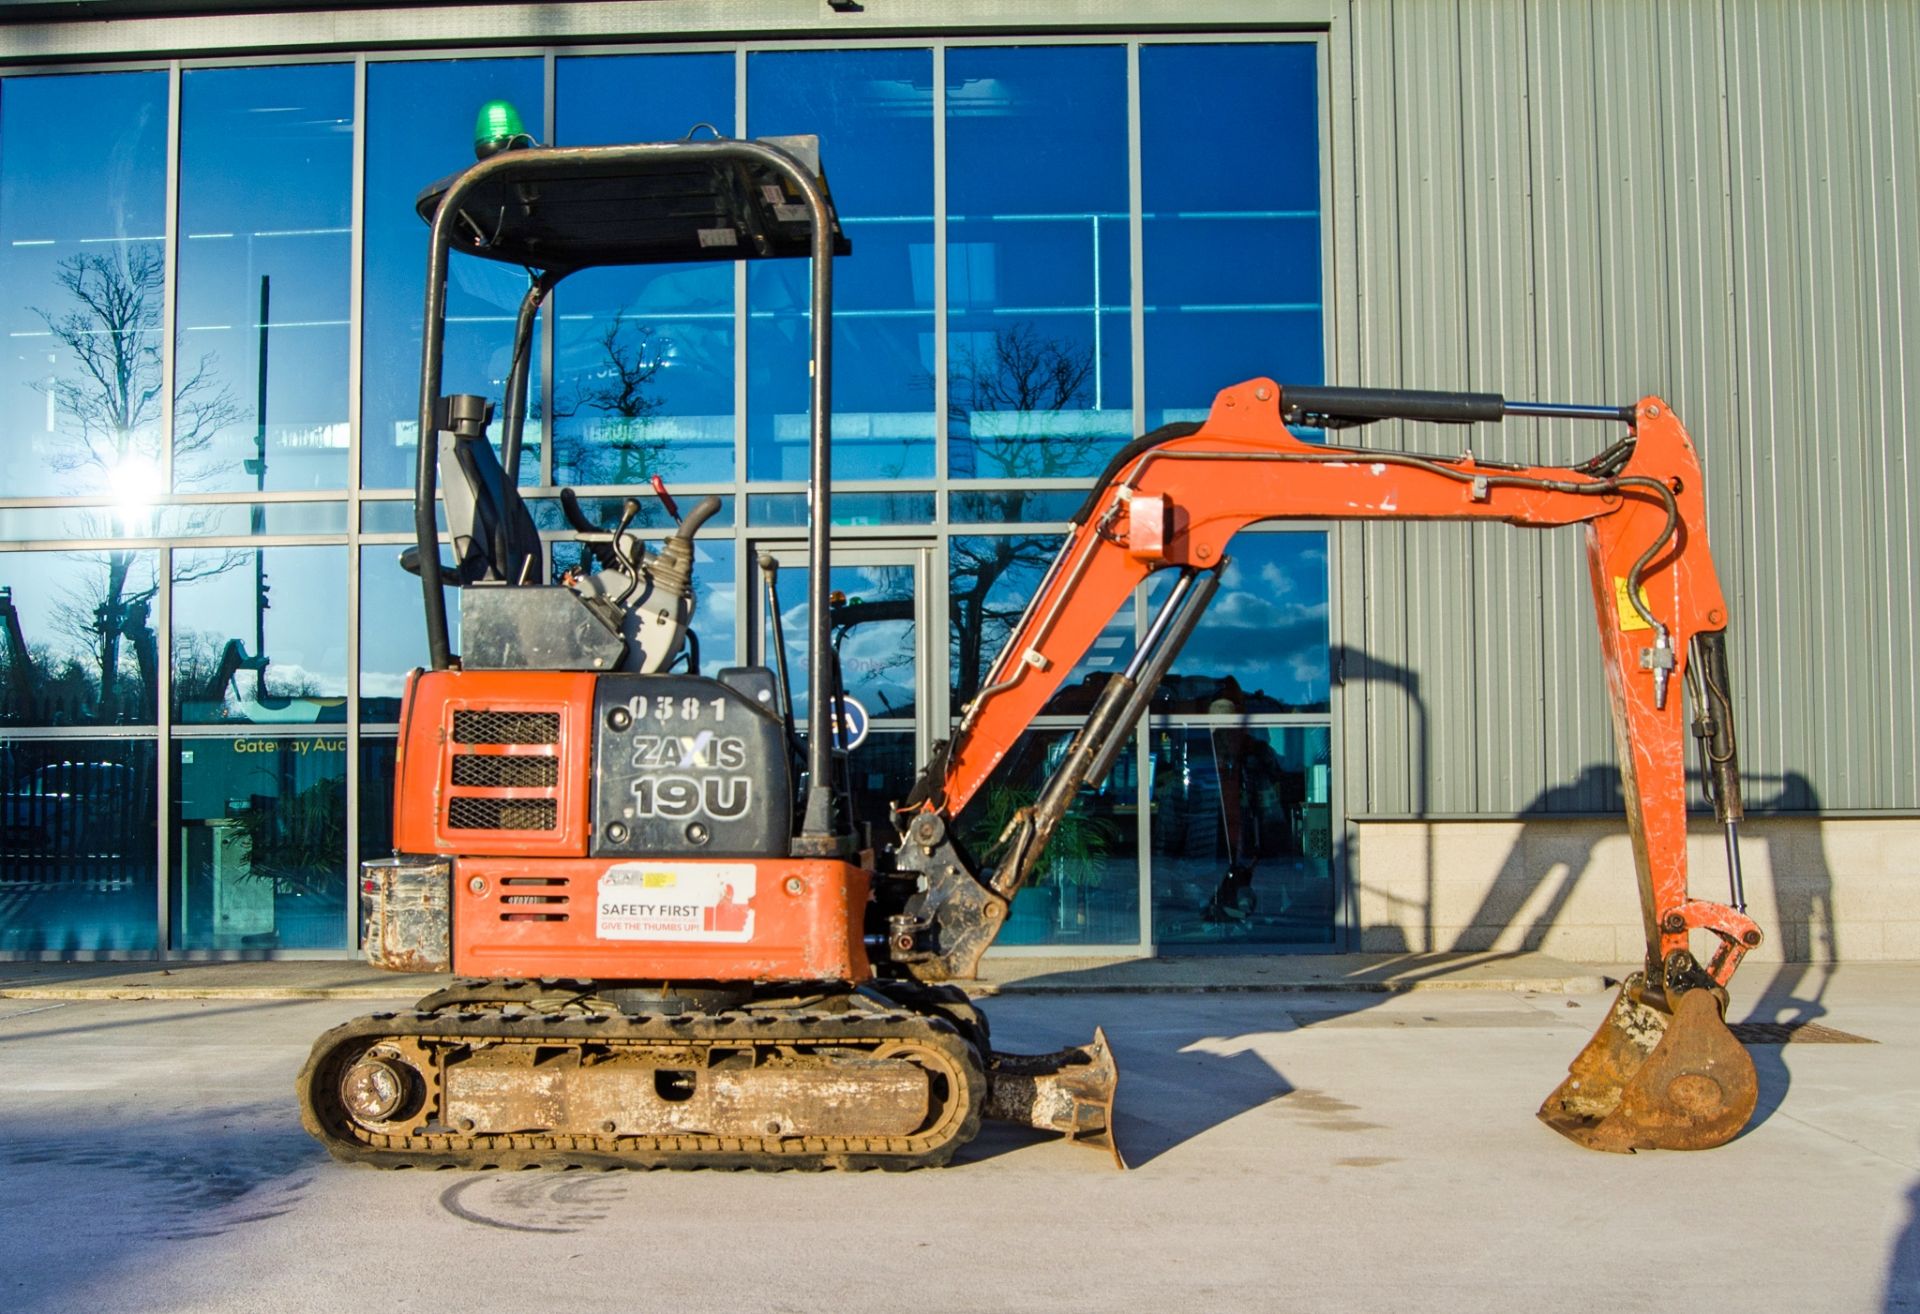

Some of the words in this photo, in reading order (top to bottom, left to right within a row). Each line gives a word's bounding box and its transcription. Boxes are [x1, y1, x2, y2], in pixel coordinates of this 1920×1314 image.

[628, 695, 727, 721] 0381
[632, 730, 746, 770] ZAXIS
[631, 775, 752, 822] 19U
[601, 903, 655, 917] SAFETY
[659, 905, 699, 917] FIRST
[601, 922, 622, 931] GIVE
[624, 922, 641, 931] THE
[643, 923, 682, 932] THUMBS
